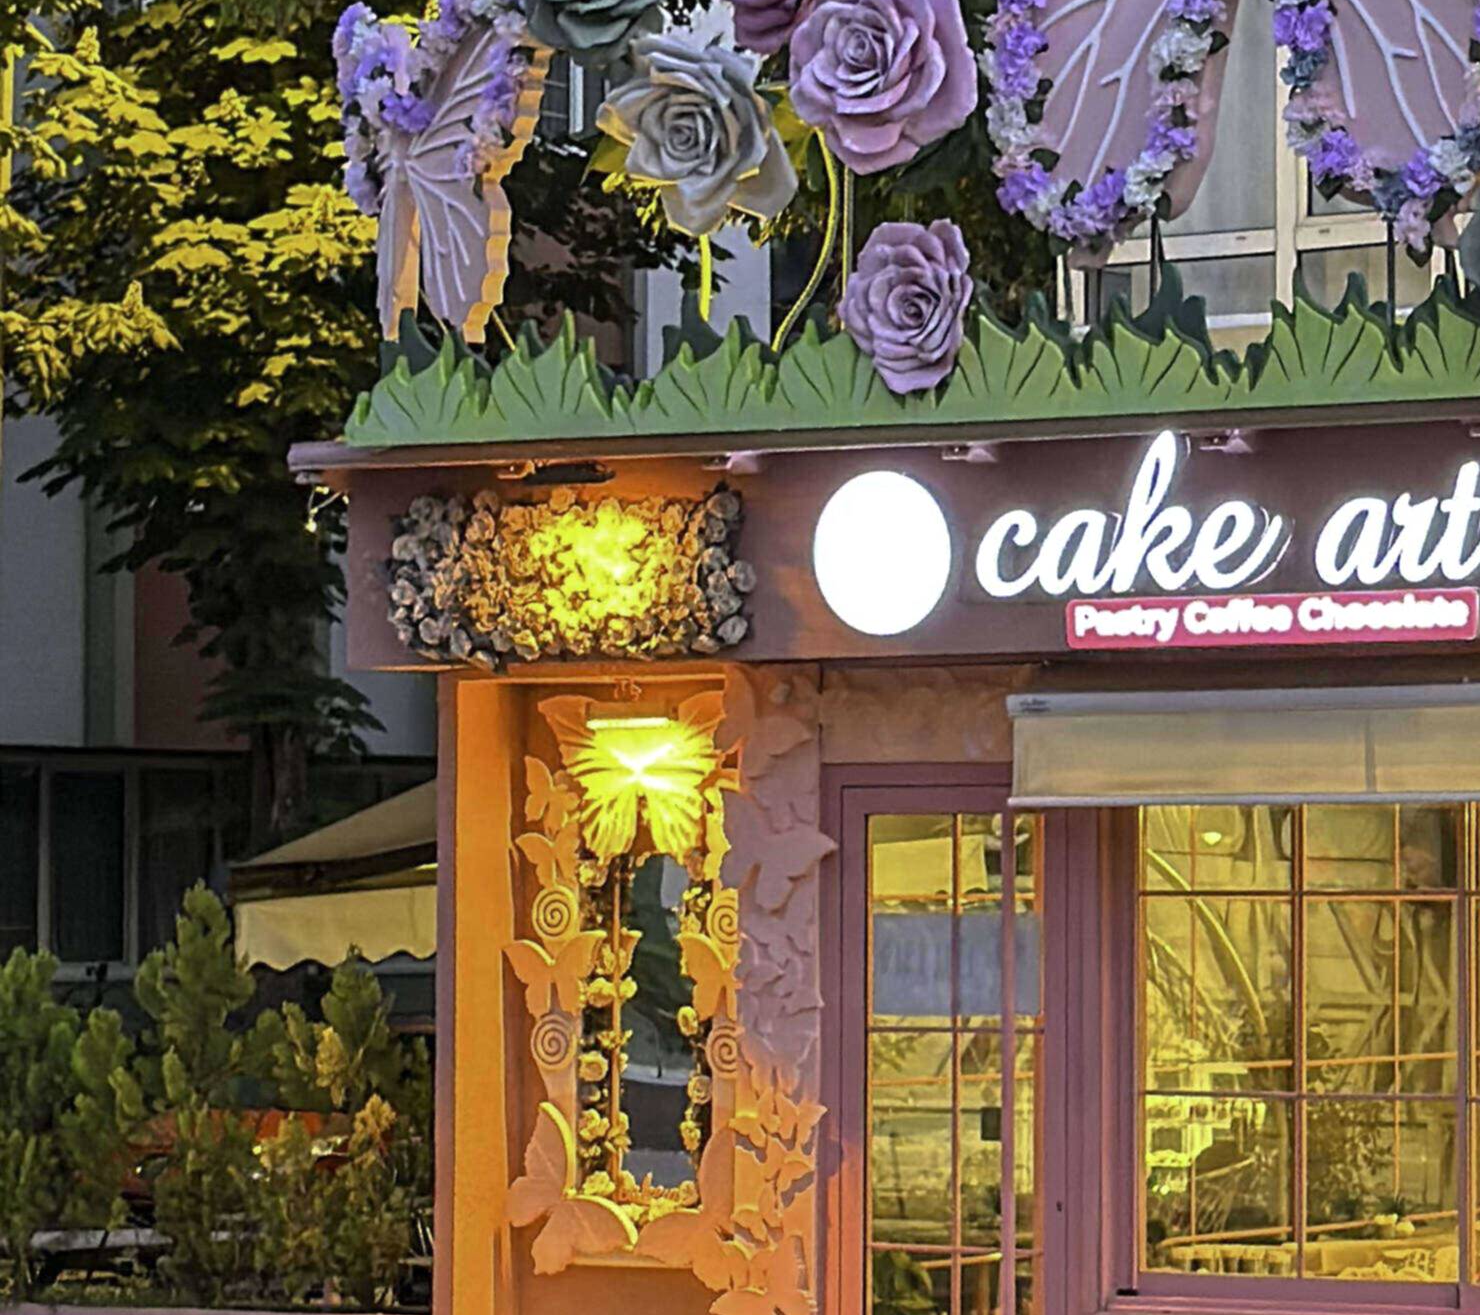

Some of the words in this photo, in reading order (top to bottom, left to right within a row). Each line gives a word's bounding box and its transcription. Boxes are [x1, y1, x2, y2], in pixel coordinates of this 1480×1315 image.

[976, 430, 1283, 597] cake
[1074, 605, 1178, 642] Pastry
[1183, 599, 1293, 633] Coffee
[1298, 594, 1469, 632] Chocolate
